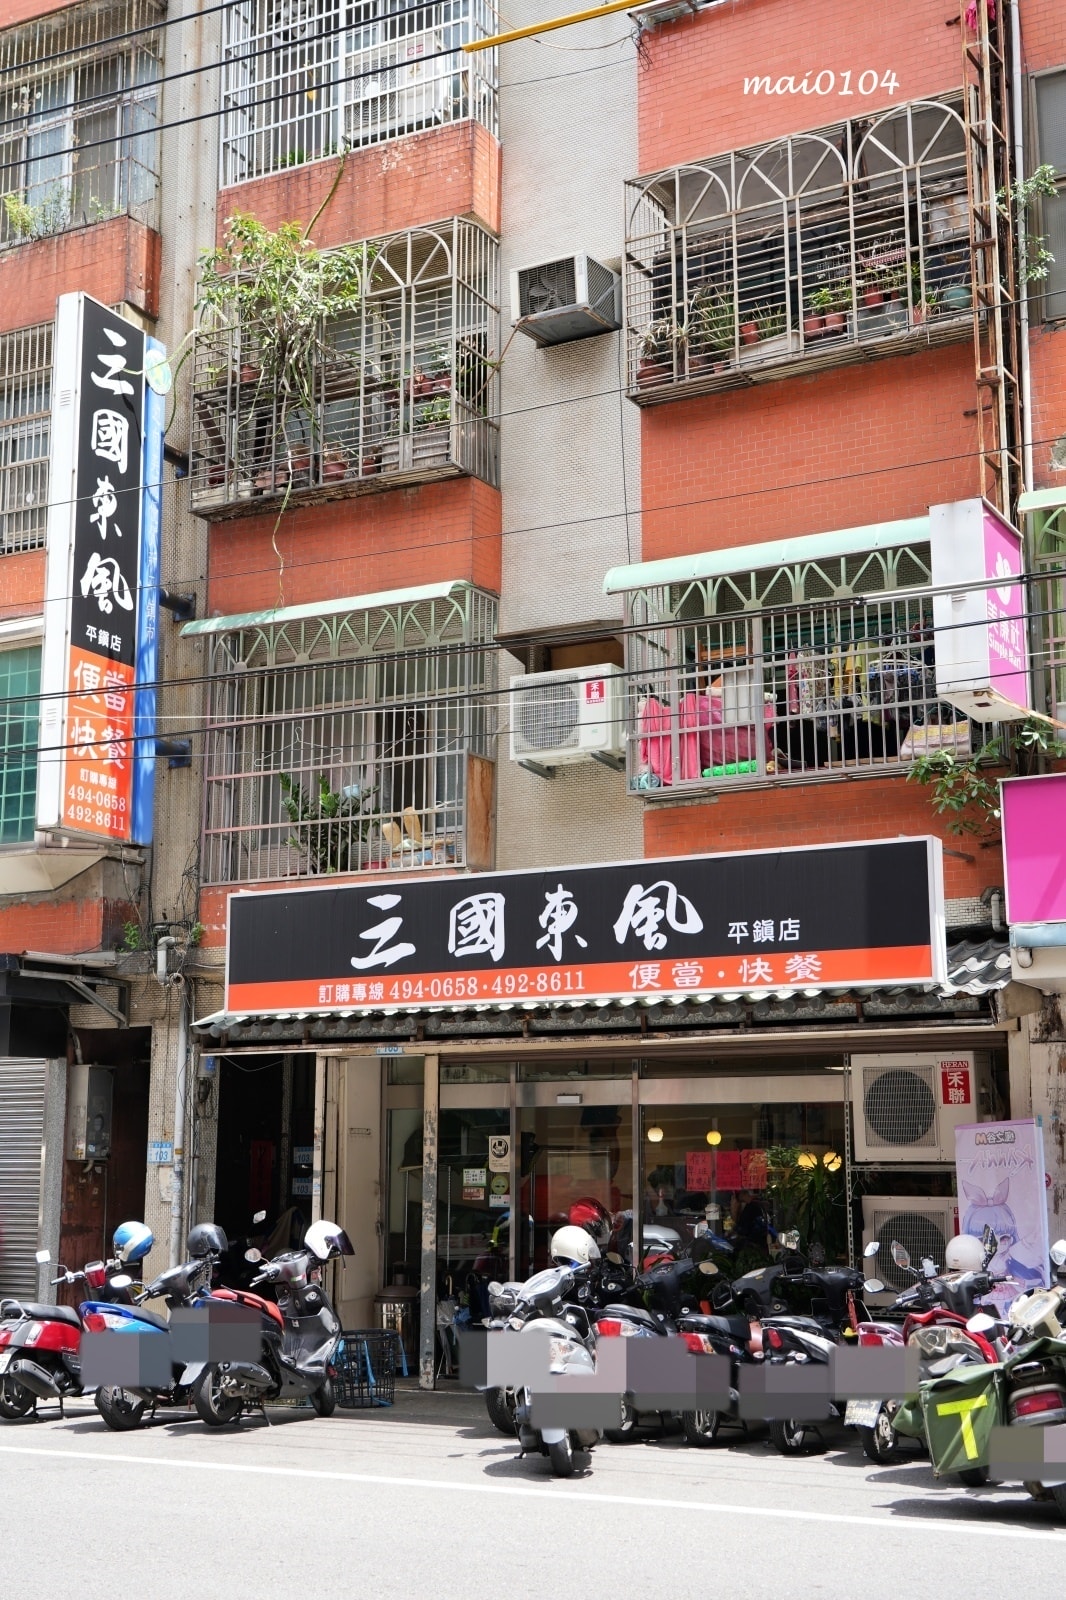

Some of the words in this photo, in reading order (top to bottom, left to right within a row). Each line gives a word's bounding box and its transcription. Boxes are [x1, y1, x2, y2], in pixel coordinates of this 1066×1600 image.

[80, 327, 134, 615] 三國東風
[73, 659, 127, 712] 便當
[71, 716, 127, 769] 快餐
[68, 784, 126, 812] 494-0658
[67, 804, 125, 831] 492-8611
[350, 880, 704, 970] 三國東風
[318, 982, 384, 1003] 訂購專線
[948, 1071, 965, 1104] 禾聯
[155, 1150, 168, 1161] 103
[297, 1153, 310, 1163] 103
[296, 1185, 309, 1194] 103
